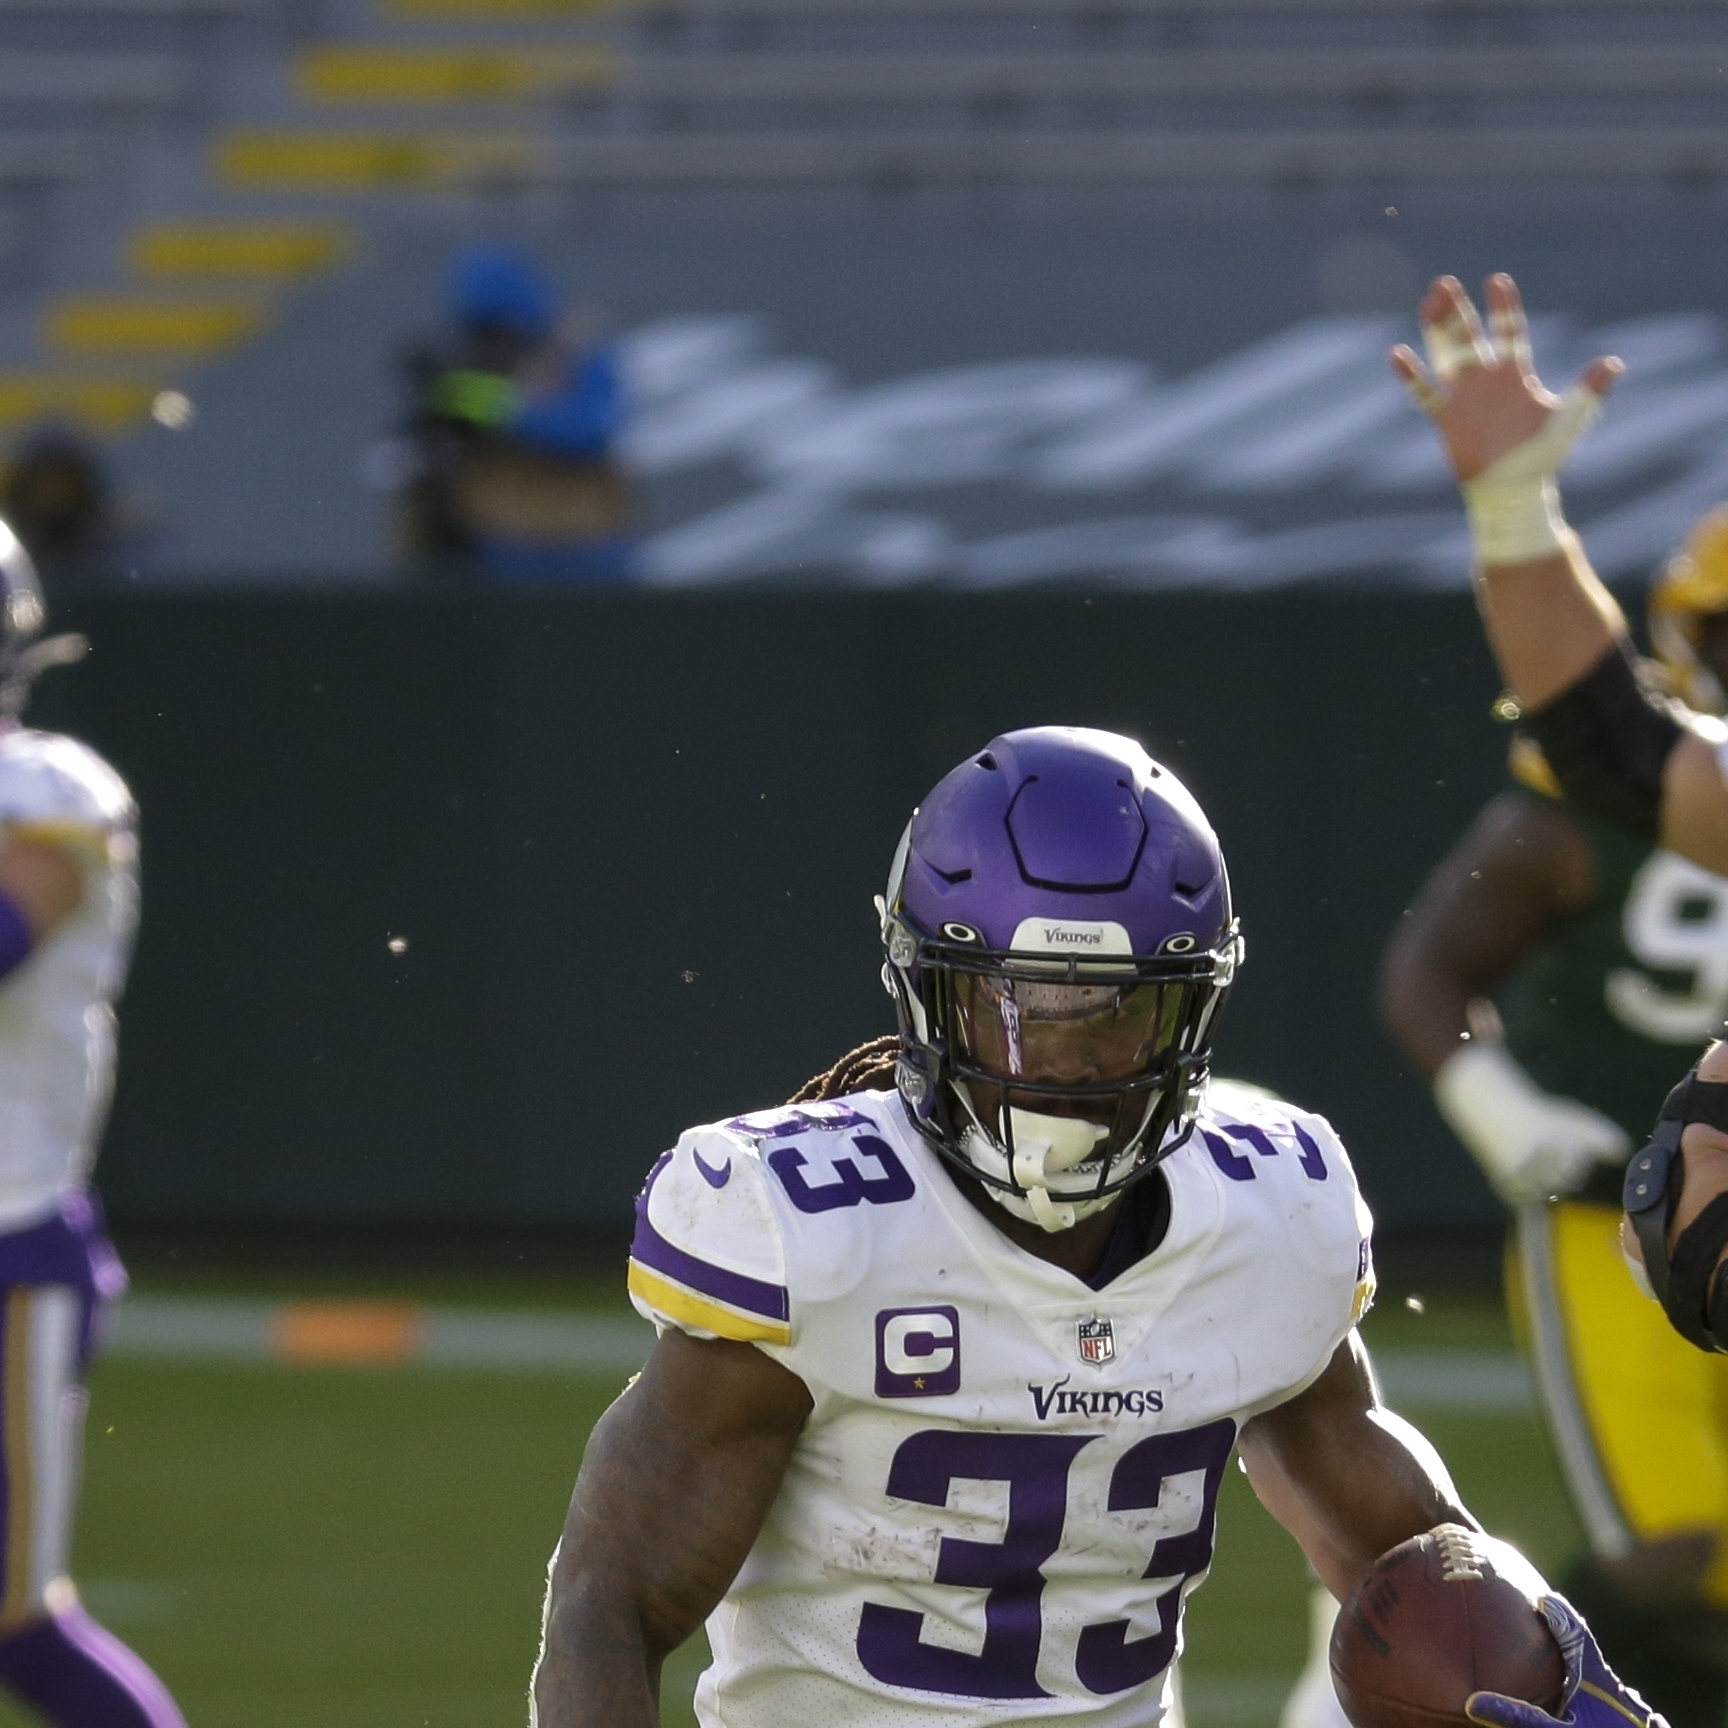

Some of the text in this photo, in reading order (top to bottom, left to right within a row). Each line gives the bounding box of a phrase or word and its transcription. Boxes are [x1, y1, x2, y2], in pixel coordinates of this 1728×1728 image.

[882, 1312, 956, 1376] C
[1081, 1338, 1115, 1361] NFL
[1027, 1373, 1165, 1420] VIKINGS
[855, 1416, 1237, 1700] 33
